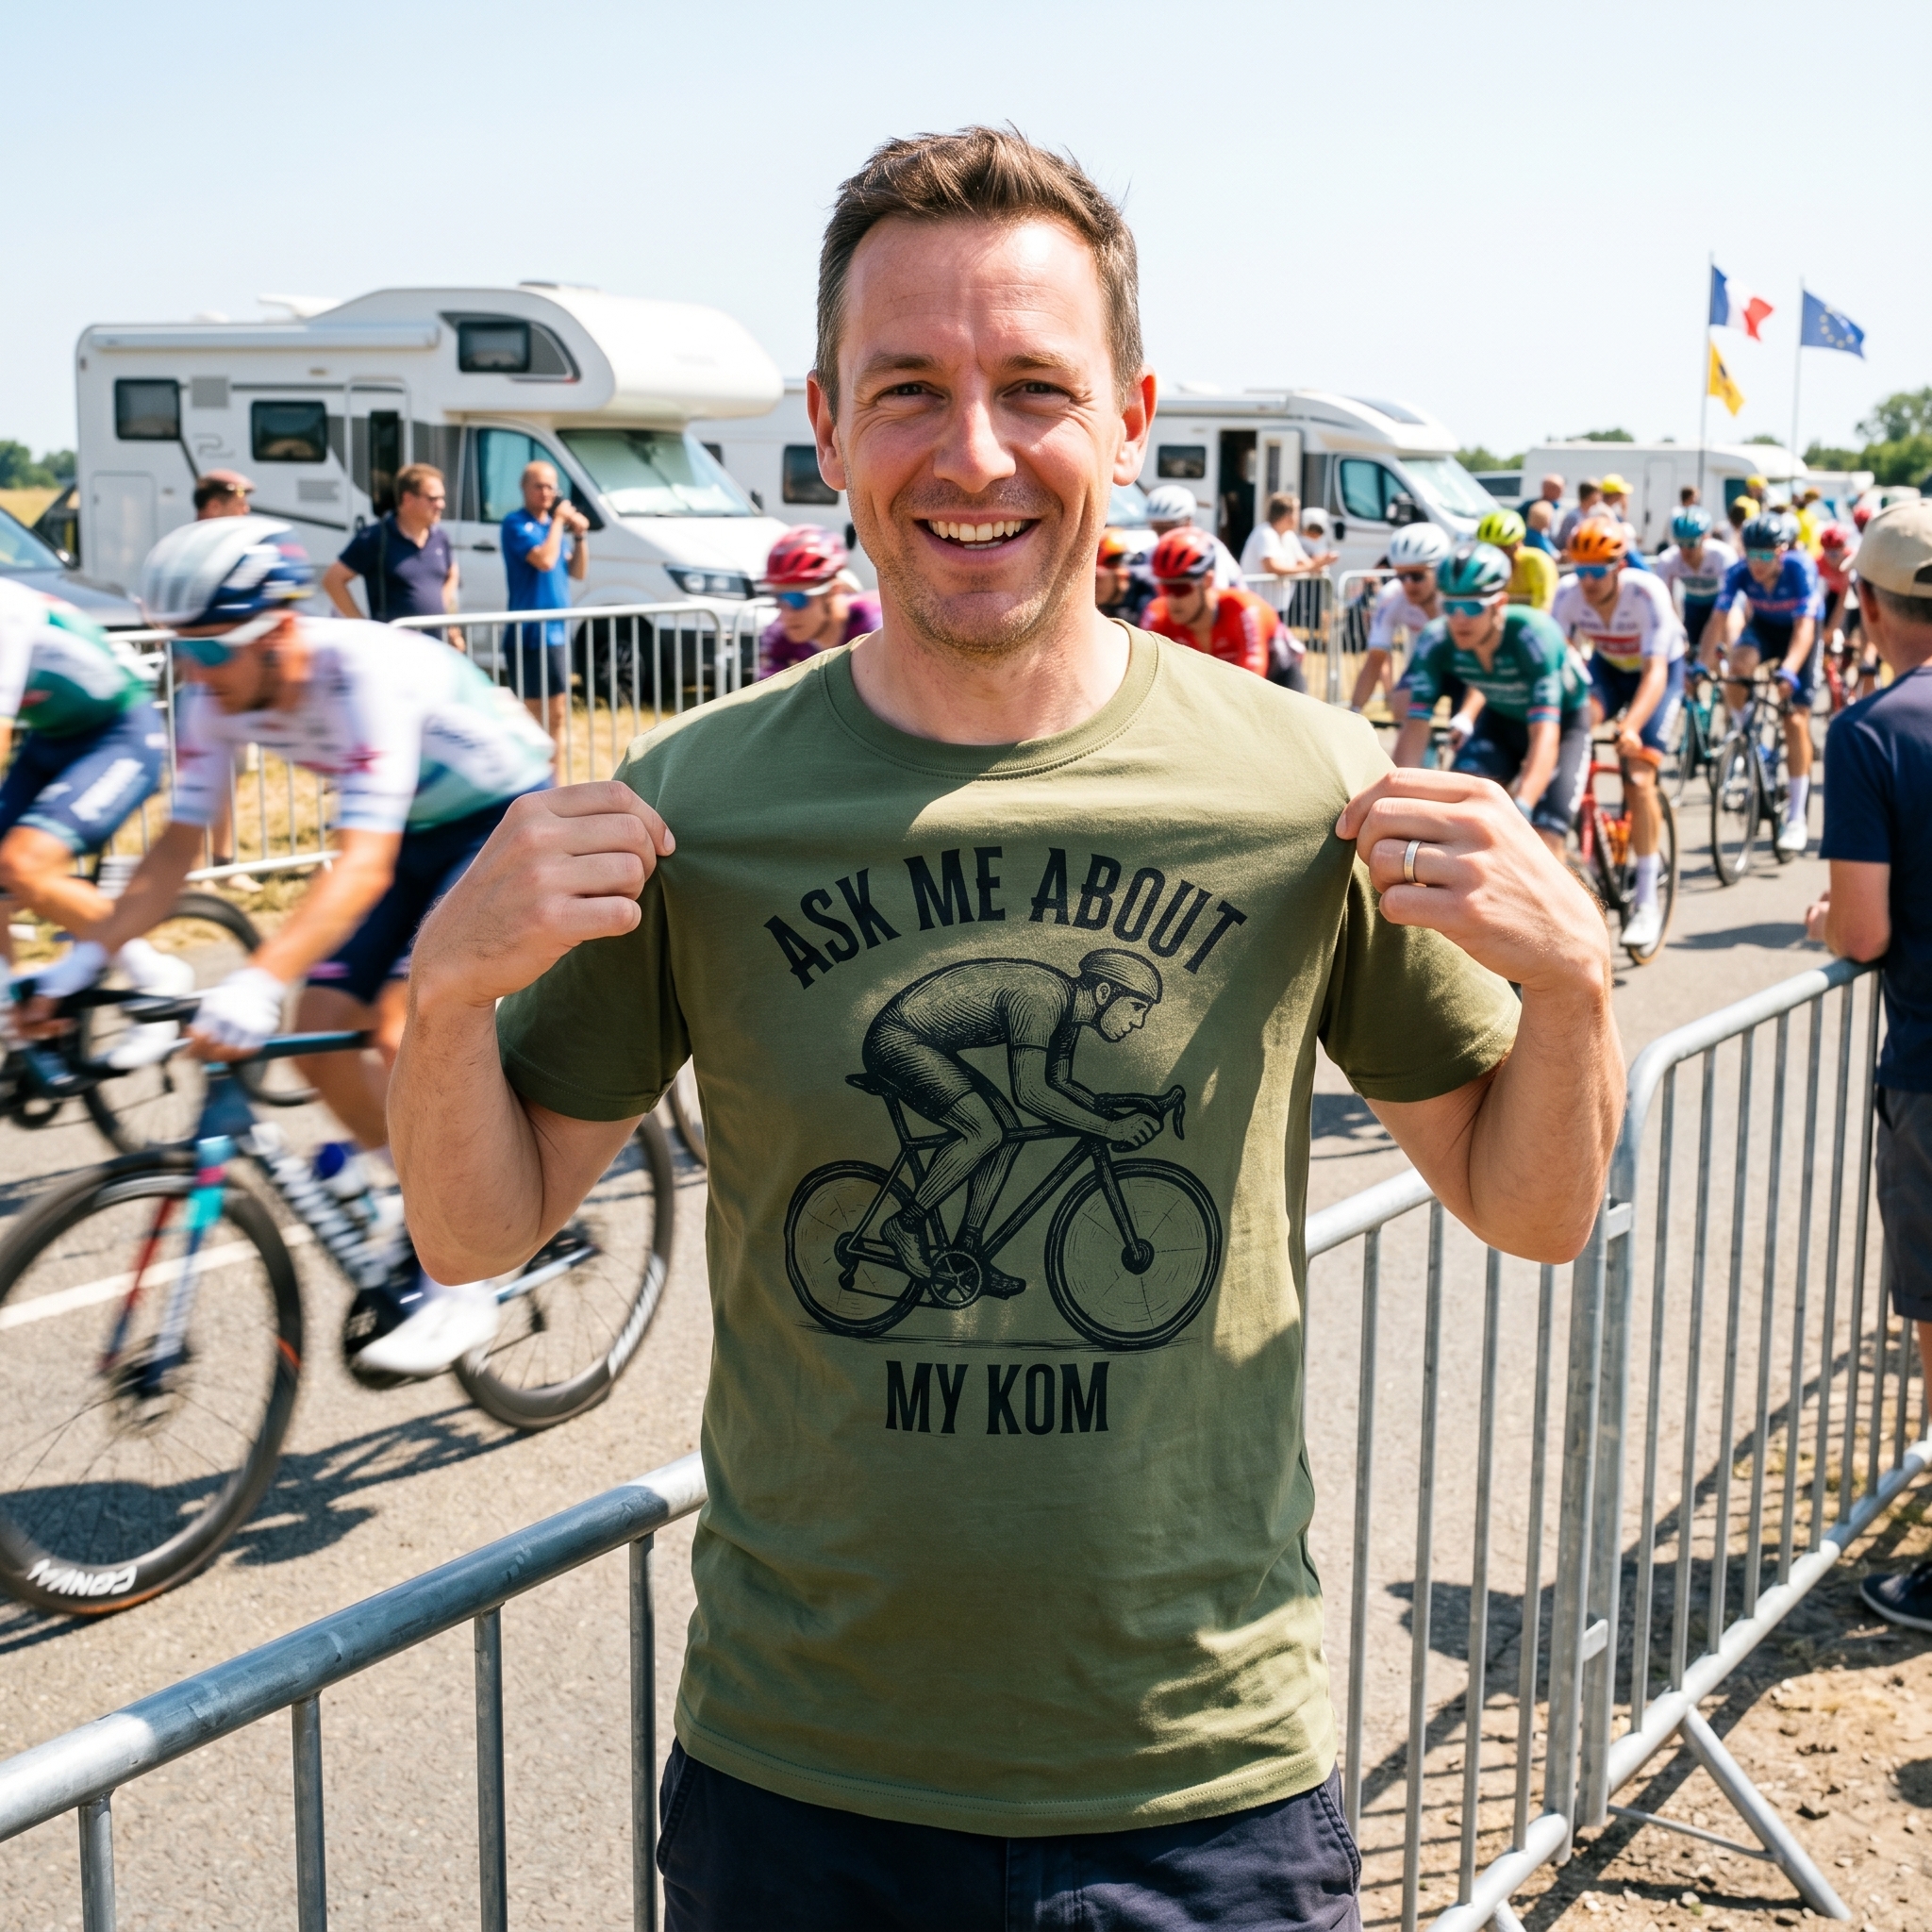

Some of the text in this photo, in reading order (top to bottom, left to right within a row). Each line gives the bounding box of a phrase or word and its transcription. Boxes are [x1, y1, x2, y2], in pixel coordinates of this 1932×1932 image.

[764, 846, 1248, 990] ASK ME ABOUT
[885, 1360, 1110, 1436] MY KOM
